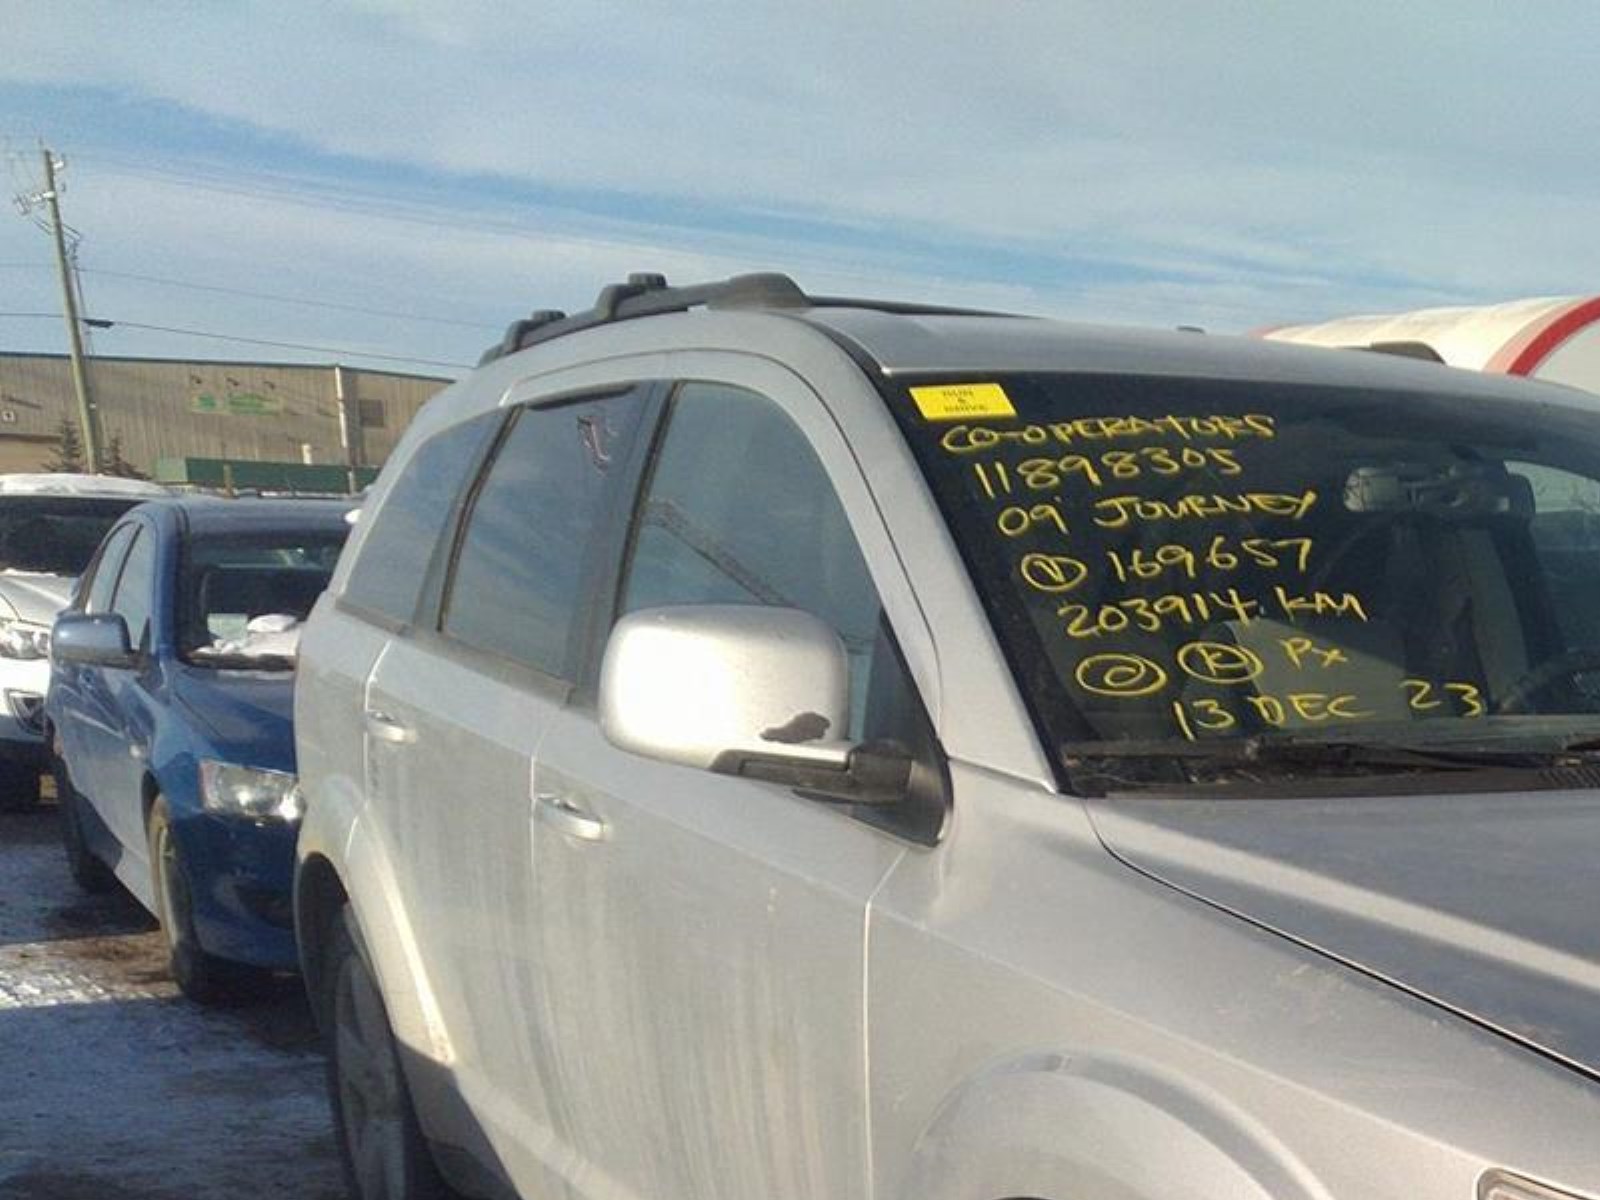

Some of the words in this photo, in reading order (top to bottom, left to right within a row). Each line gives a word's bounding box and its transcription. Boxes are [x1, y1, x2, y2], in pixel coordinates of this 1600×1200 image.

[974, 447, 1242, 499] 11898305
[998, 502, 1069, 536] 09
[1093, 490, 1317, 528] JOURNEY
[1107, 536, 1312, 583] 169657
[1058, 588, 1258, 638] 203914
[1275, 587, 1369, 622] KM
[1172, 699, 1235, 741] 13
[1248, 692, 1374, 728] DEC
[1401, 679, 1484, 717] 23
